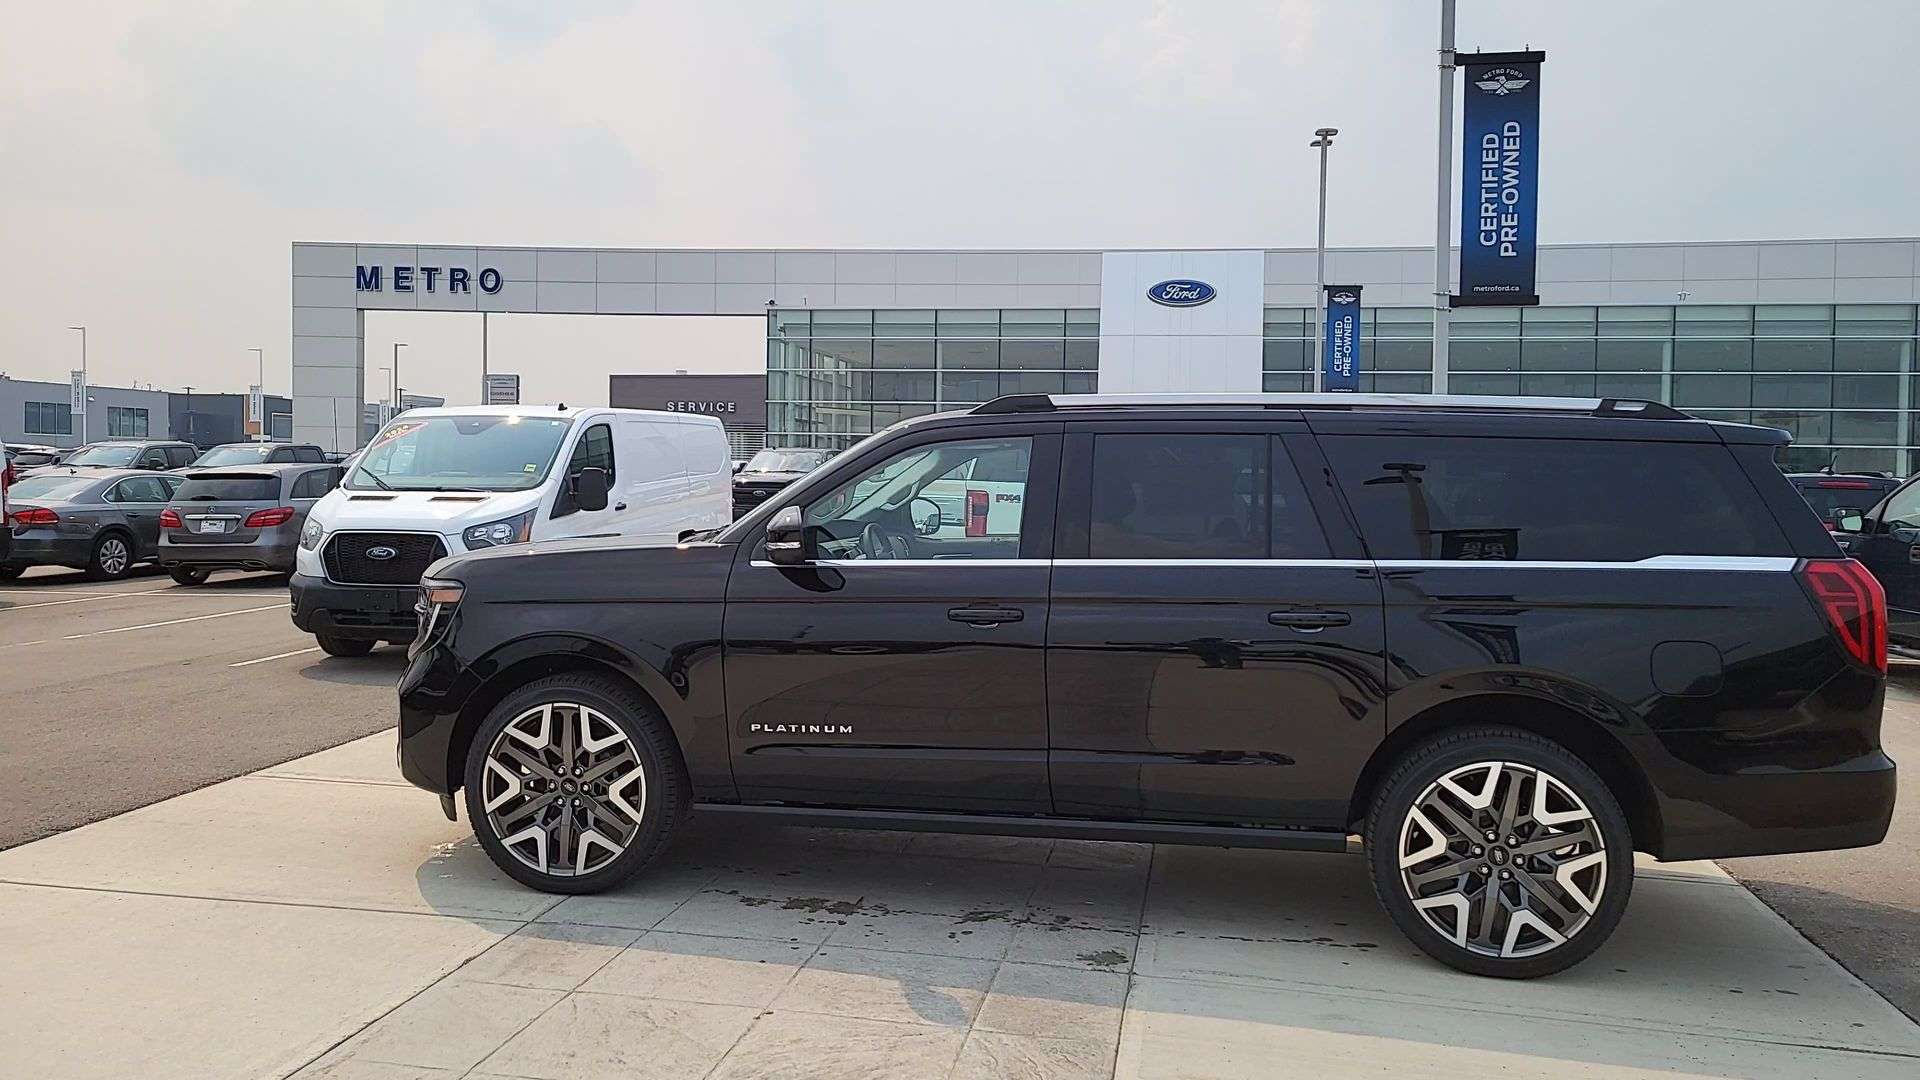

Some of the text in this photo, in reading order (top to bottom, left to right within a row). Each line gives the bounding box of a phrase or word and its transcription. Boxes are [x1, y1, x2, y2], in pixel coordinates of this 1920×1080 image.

[1482, 68, 1523, 79] METRO FORD
[1480, 133, 1500, 246] CERTIFIED
[1500, 121, 1521, 257] PRE-OWNED
[356, 265, 503, 294] METRO
[1473, 285, 1520, 293] metroford.ca
[1162, 284, 1201, 300] Ford
[1334, 321, 1343, 372] CERTIFIED
[1343, 316, 1352, 377] PRE-OWNED
[666, 400, 737, 413] SERVICE
[750, 723, 853, 733] PLATINUM
